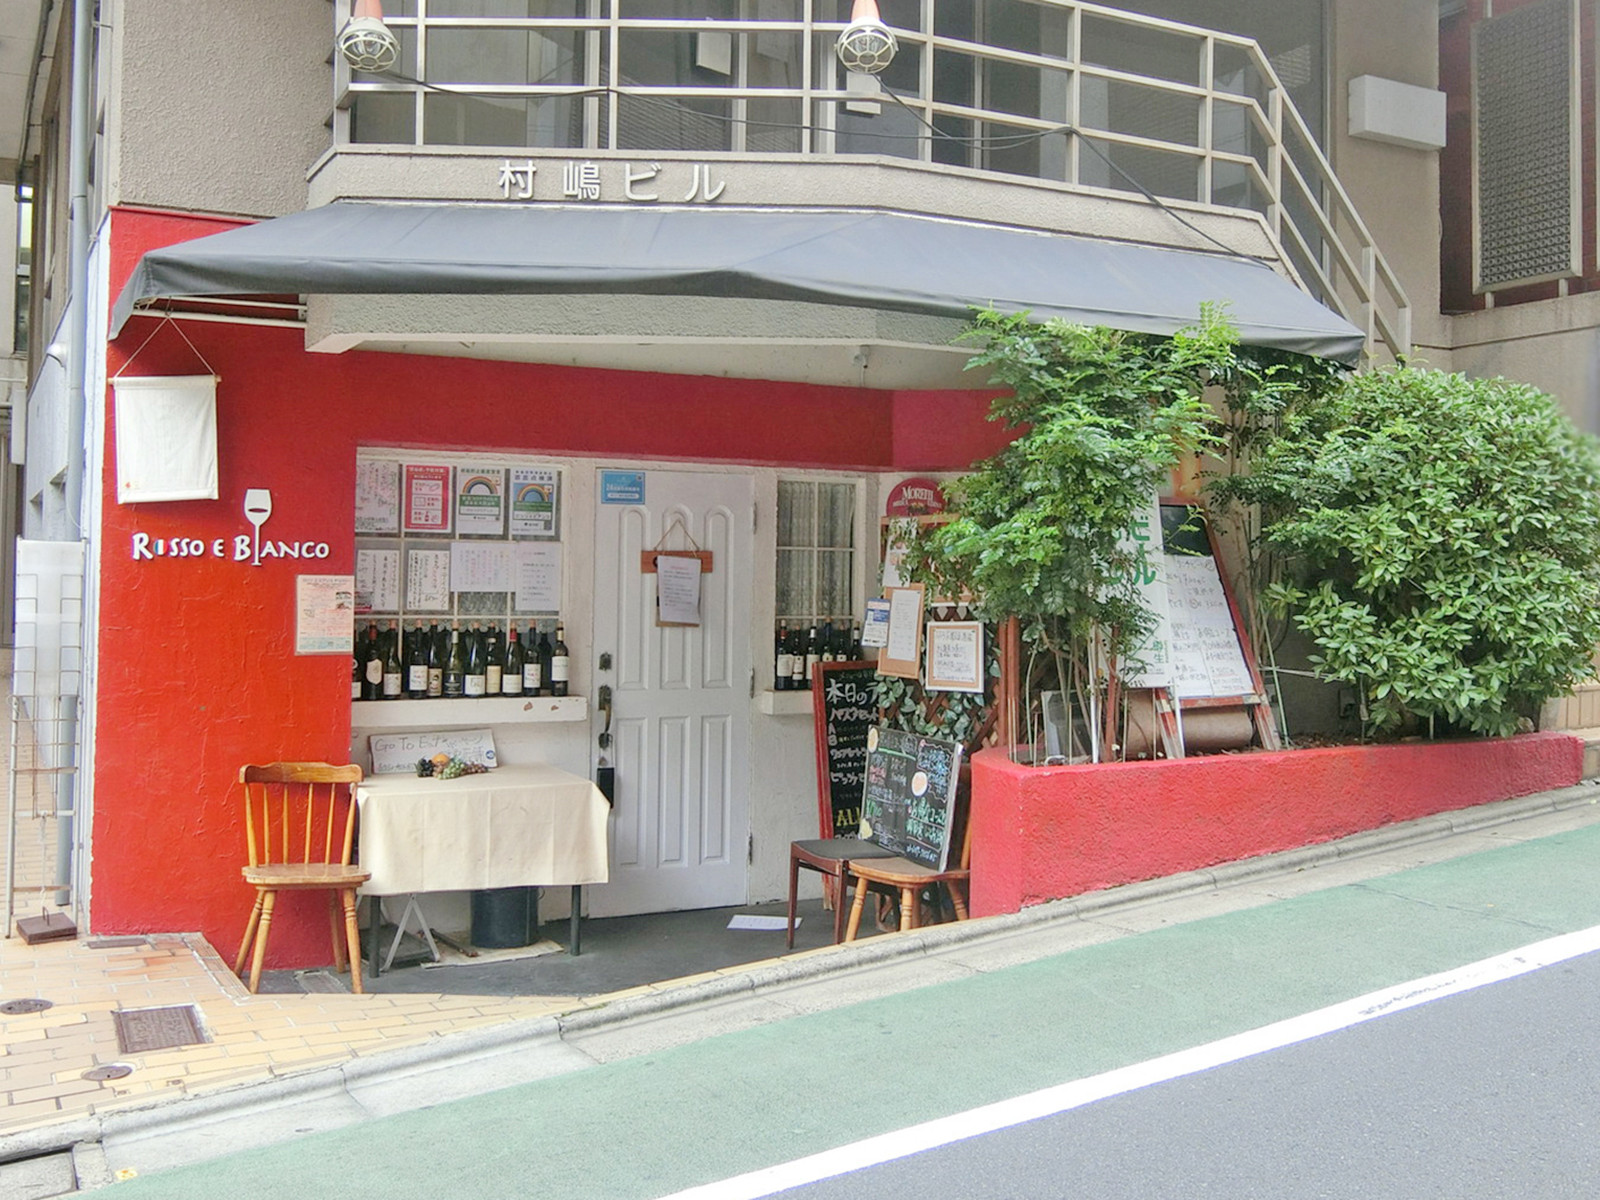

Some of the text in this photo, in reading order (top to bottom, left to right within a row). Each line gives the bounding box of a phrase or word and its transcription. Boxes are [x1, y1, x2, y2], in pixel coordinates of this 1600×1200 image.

[498, 159, 727, 201] 村嶋ビル
[213, 538, 225, 558] E
[234, 533, 330, 566] BIANCO
